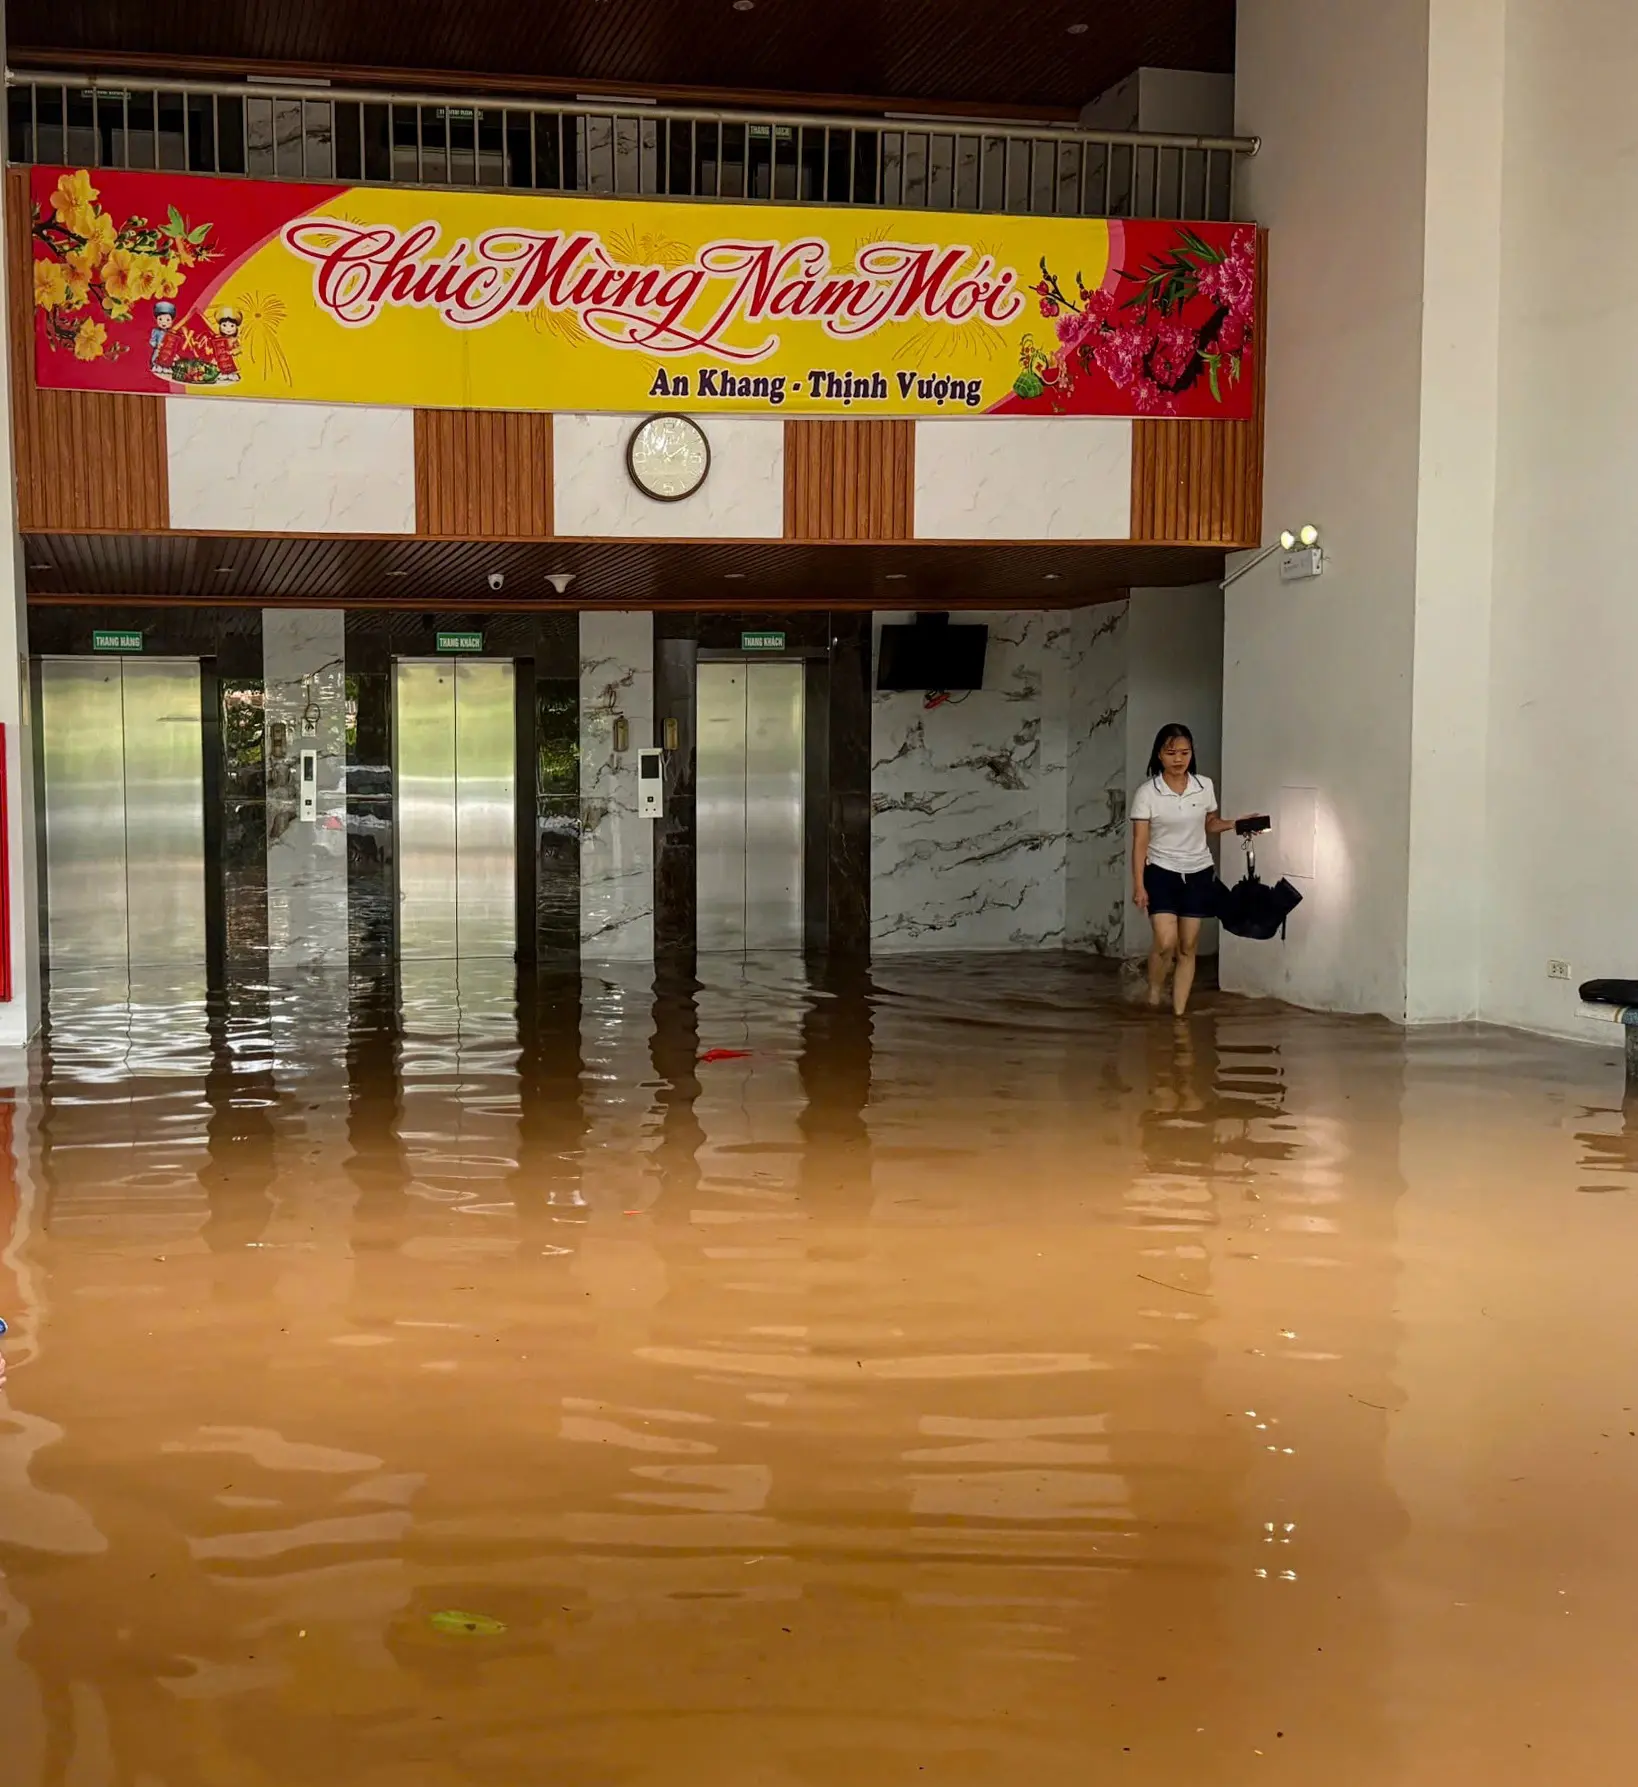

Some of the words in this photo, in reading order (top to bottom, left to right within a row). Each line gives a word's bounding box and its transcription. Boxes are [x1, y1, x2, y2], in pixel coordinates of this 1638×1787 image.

[285, 223, 500, 322] Chúc
[446, 235, 725, 354] Mừng
[660, 242, 880, 352] Năm
[828, 246, 1020, 335] Mới
[649, 367, 690, 396] An
[697, 368, 786, 405] Khang
[808, 370, 888, 405] Thịnh
[896, 371, 982, 406] Vượng
[96, 636, 119, 647] THANG
[440, 637, 459, 647] THANG
[744, 637, 763, 647] THANG
